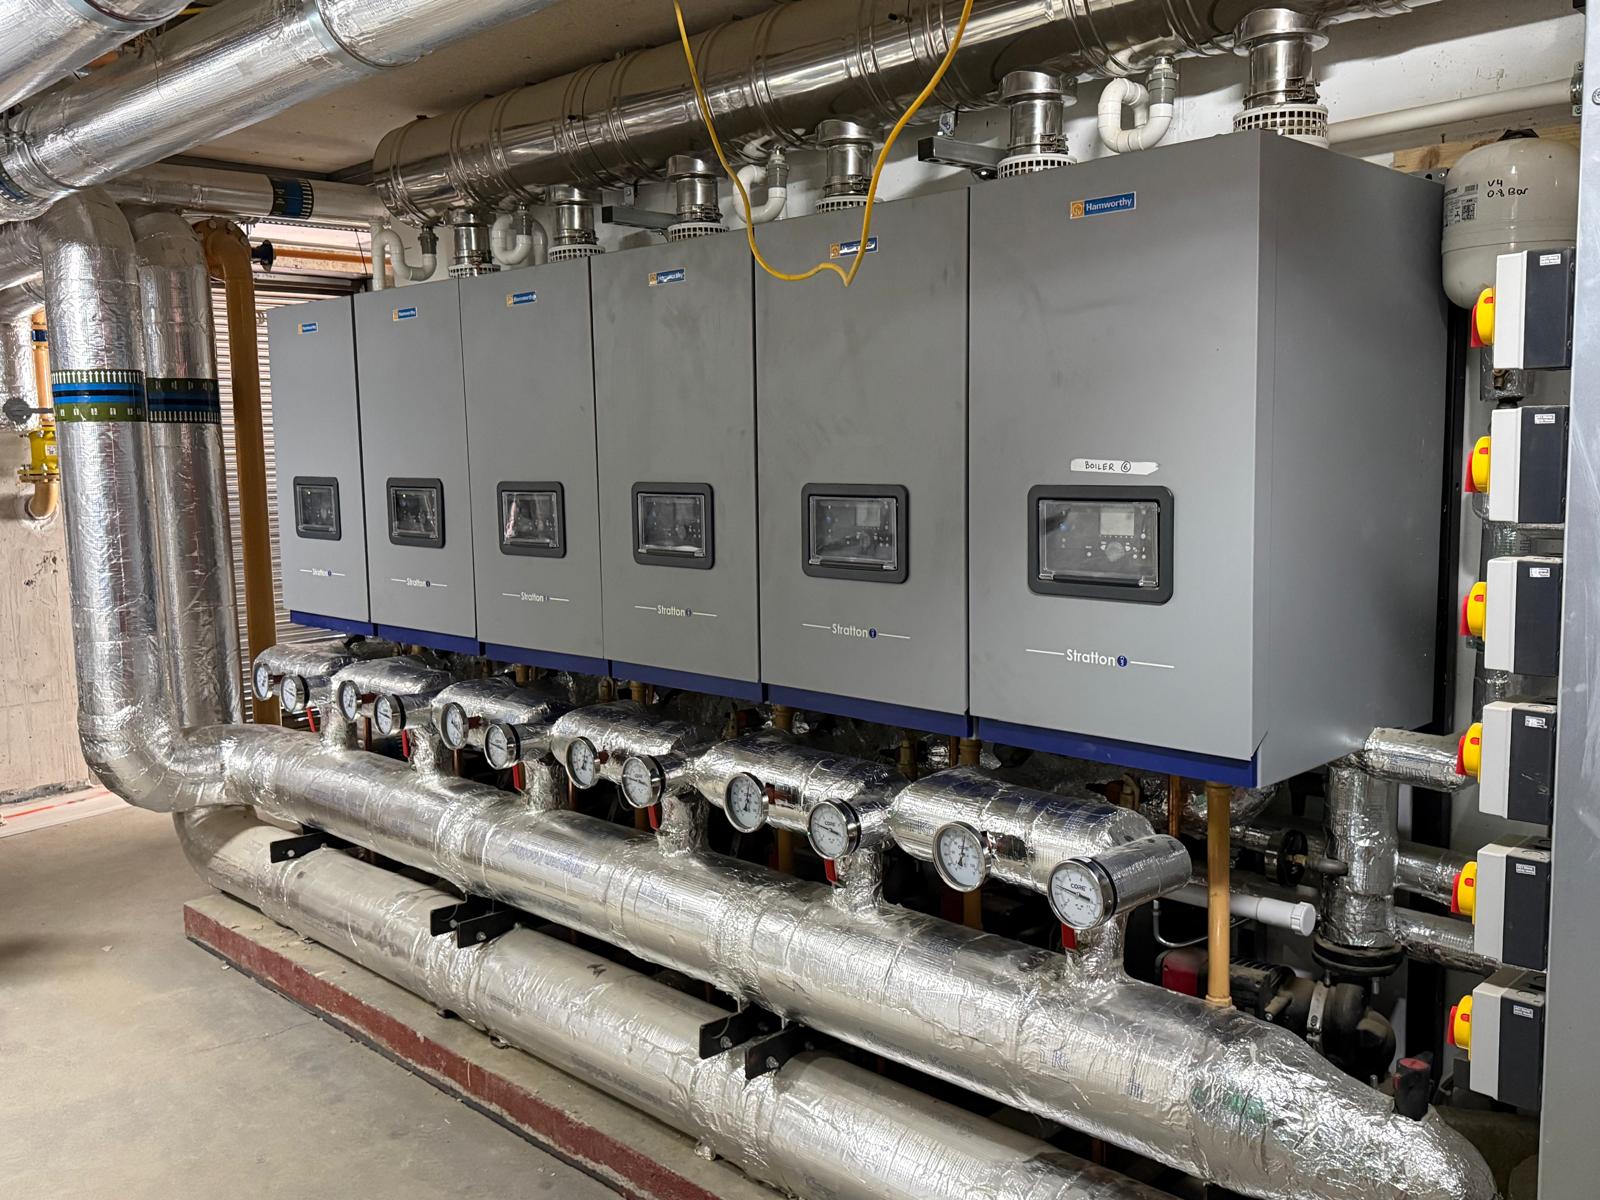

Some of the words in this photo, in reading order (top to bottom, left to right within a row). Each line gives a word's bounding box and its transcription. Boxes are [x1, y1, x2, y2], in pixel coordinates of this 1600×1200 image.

[1508, 187, 1528, 196] Bar
[1086, 197, 1132, 211] Hamworthy
[1084, 460, 1115, 471] BOILER
[520, 591, 544, 602] Stratton
[657, 604, 686, 617] Stratton
[831, 623, 868, 638] Stratton
[1066, 648, 1116, 667] Stratton
[1070, 882, 1087, 892] CORE
